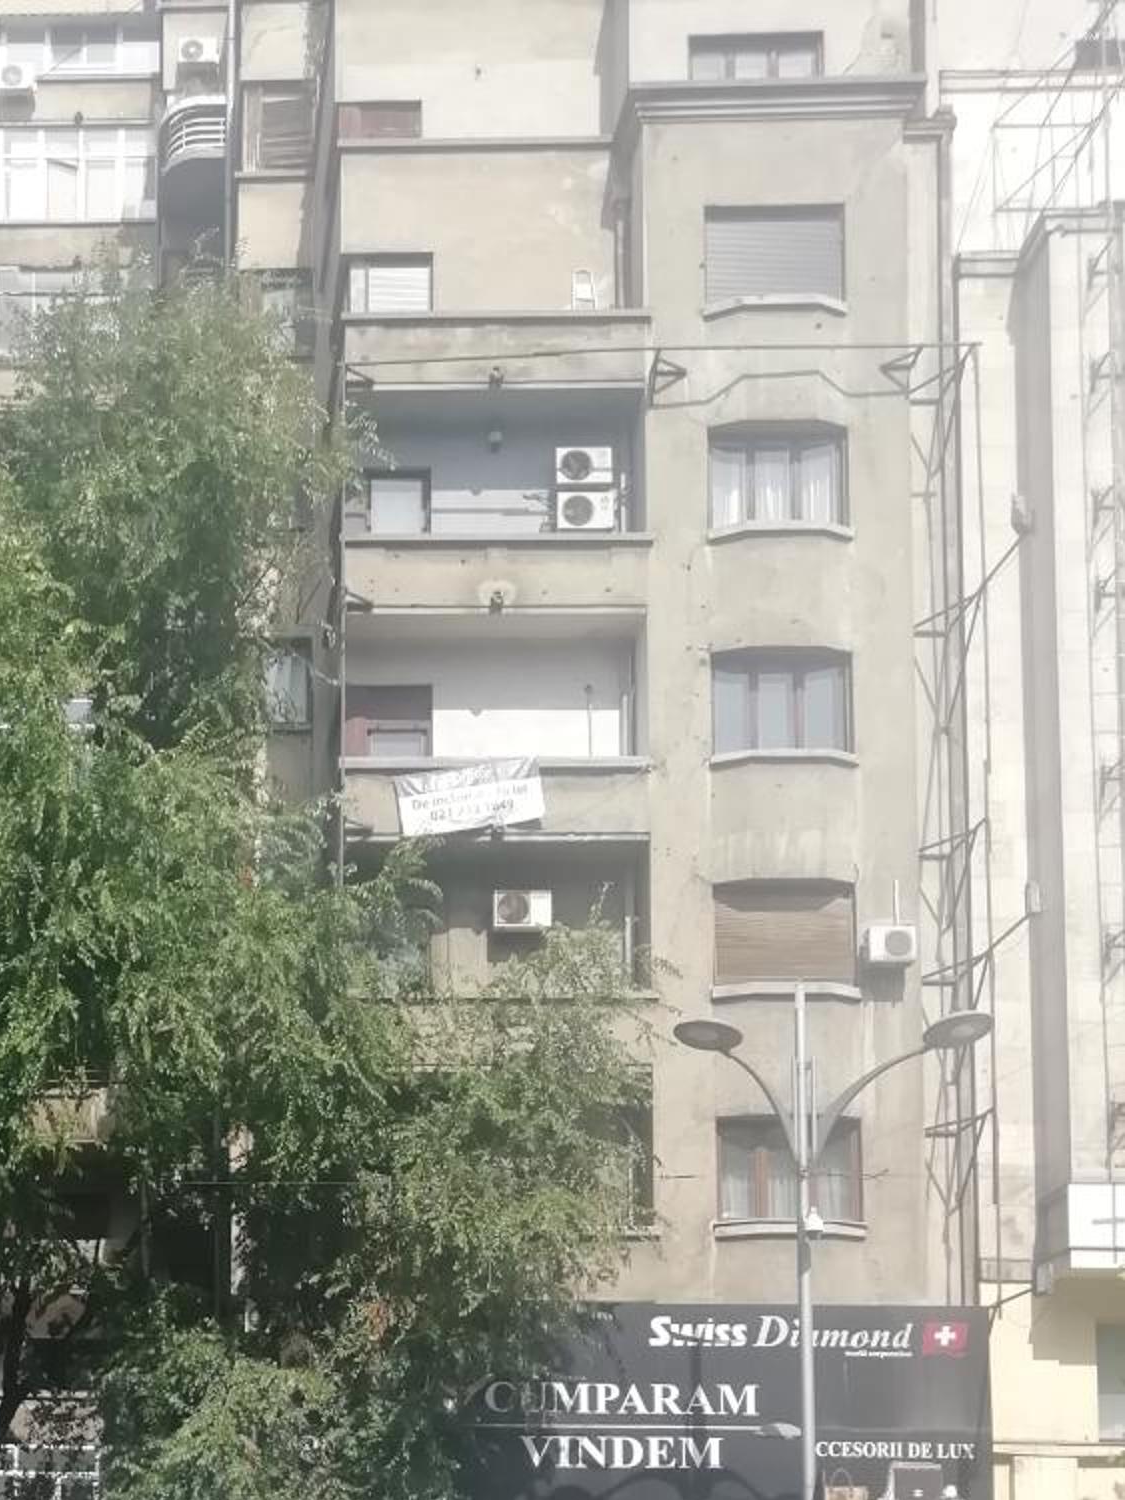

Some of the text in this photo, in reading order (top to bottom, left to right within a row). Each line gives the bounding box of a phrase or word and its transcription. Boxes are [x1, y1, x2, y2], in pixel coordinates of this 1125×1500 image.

[648, 1315, 913, 1349] Swiss Dimond
[485, 1381, 760, 1416] CUMPARAM
[520, 1435, 725, 1470] VINDEM
[815, 1441, 976, 1460] CCESORII DE LUX
